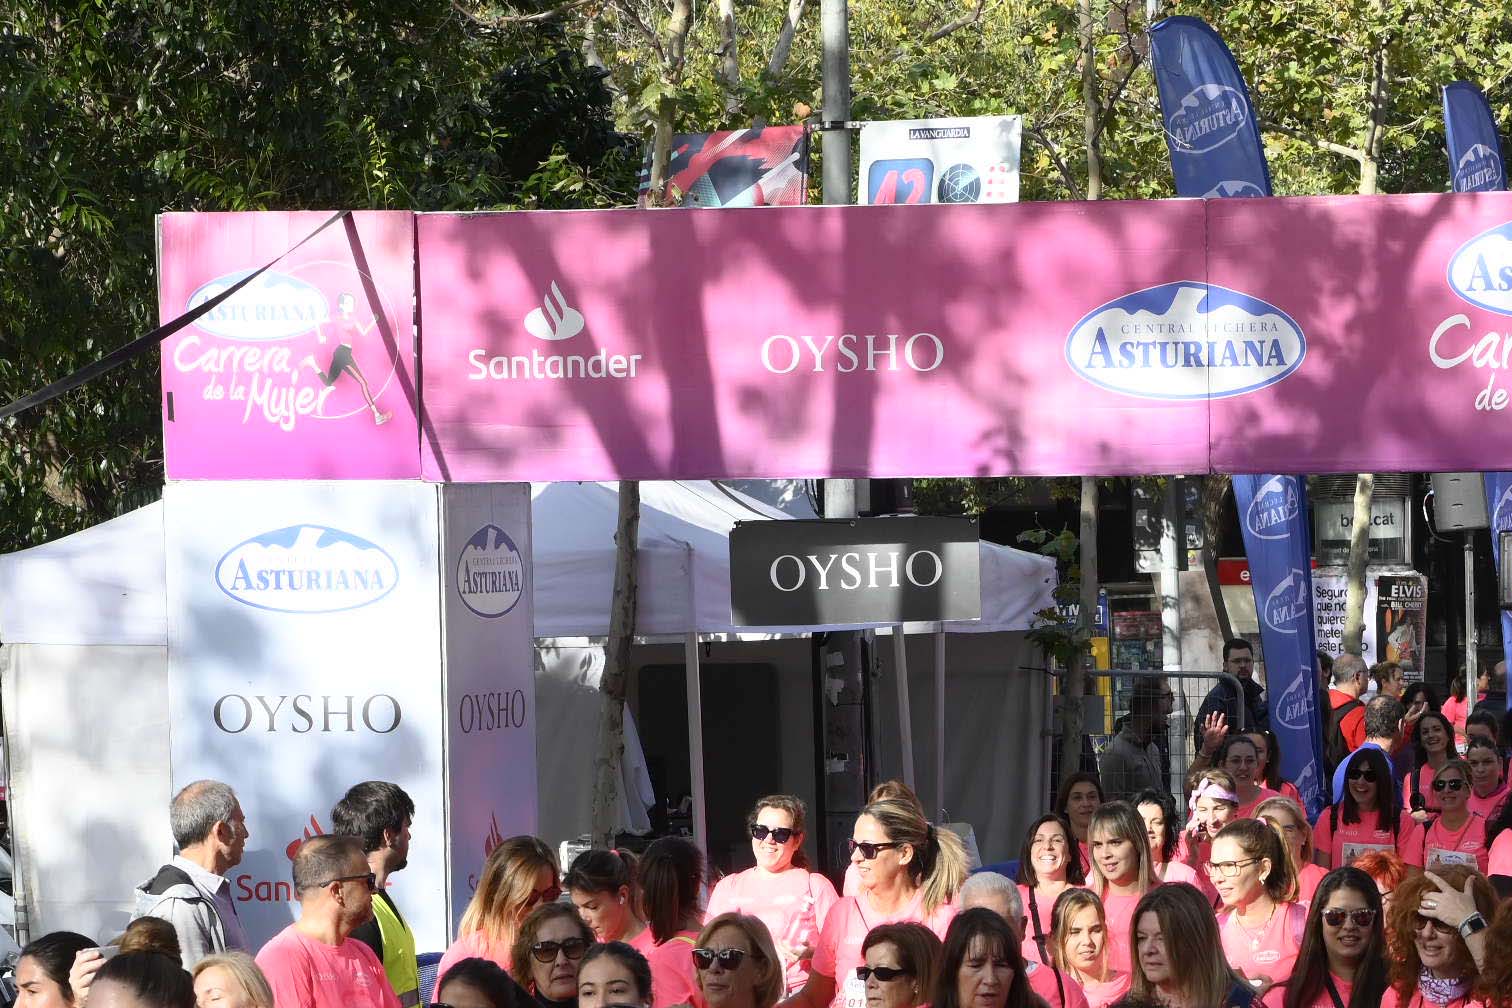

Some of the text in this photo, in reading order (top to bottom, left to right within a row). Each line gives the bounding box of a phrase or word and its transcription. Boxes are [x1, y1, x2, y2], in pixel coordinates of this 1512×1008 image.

[920, 128, 969, 138] VANGUARDIA
[174, 336, 292, 373] Carrera
[468, 347, 642, 380] Santander
[760, 332, 945, 374] OYSHO
[1085, 326, 1288, 370] ASTURIANA
[203, 368, 336, 432] de la Mujer
[1474, 372, 1507, 411] de
[229, 557, 385, 592] ASTURIANA
[461, 558, 521, 596] ASTURIANA
[768, 549, 944, 593] OYSHO
[1317, 602, 1333, 613] que
[1391, 585, 1422, 598] ELVIS
[1391, 601, 1402, 609] BILL
[1318, 641, 1337, 652] este
[212, 693, 403, 735] OYSHO
[458, 689, 527, 735] OYSHO
[848, 998, 870, 1008] 01
